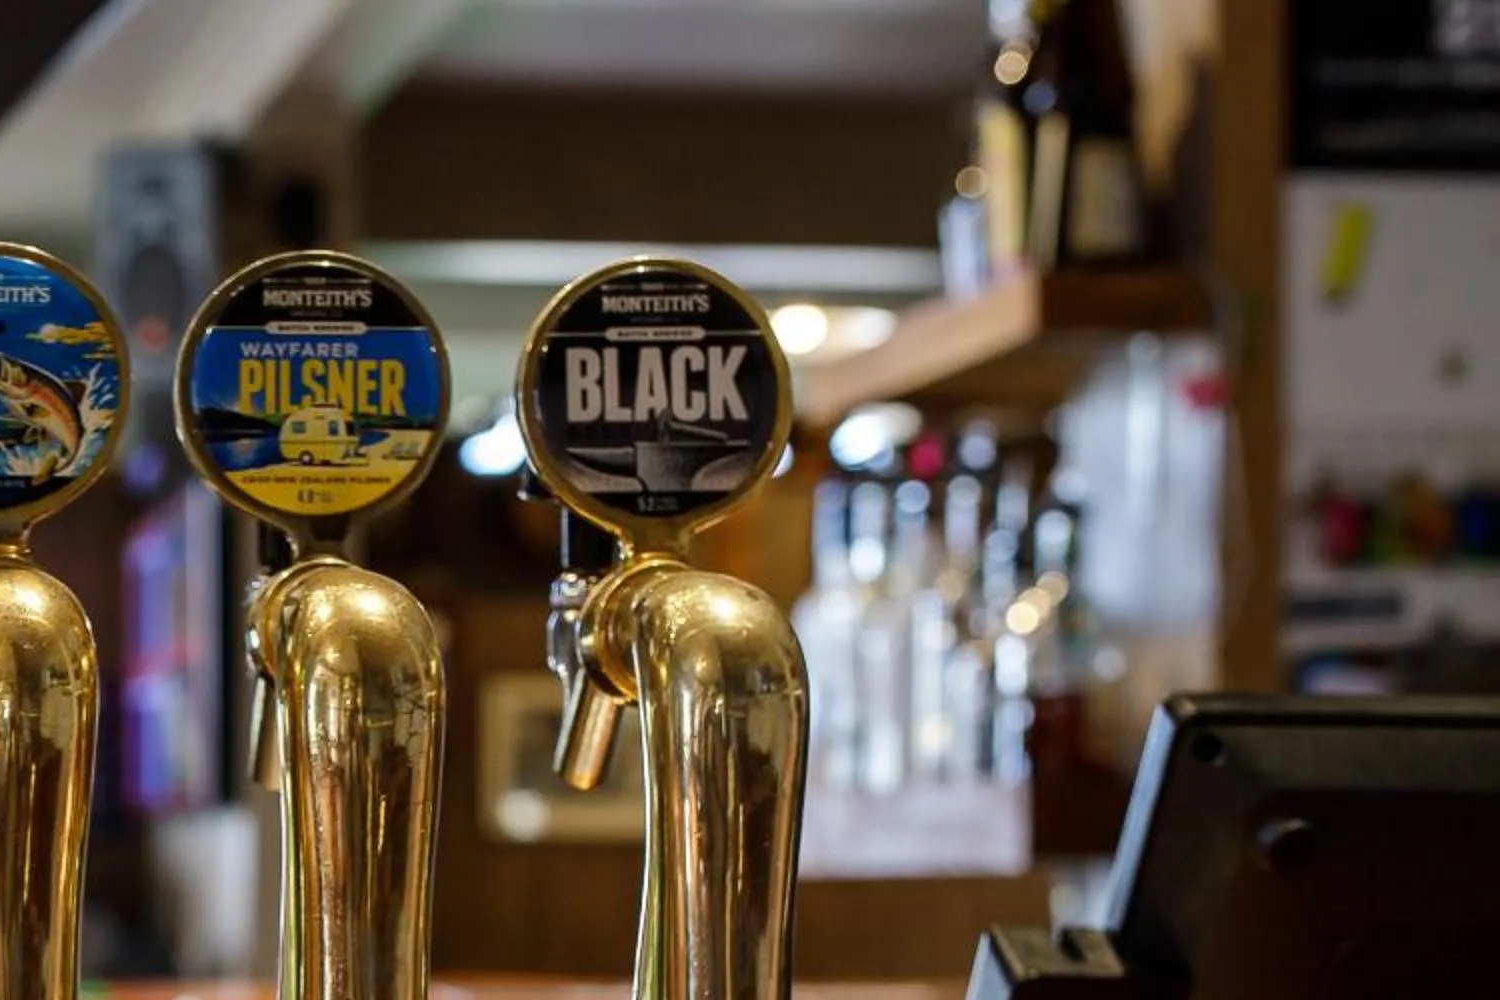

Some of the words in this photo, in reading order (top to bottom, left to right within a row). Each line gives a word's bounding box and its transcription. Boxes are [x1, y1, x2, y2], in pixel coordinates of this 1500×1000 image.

[262, 289, 373, 308] MONTEITH'S
[601, 293, 710, 313] MONTEITH'S
[240, 342, 359, 358] WAYFARER
[238, 359, 407, 419] PILSNER
[565, 346, 749, 424] BLACK
